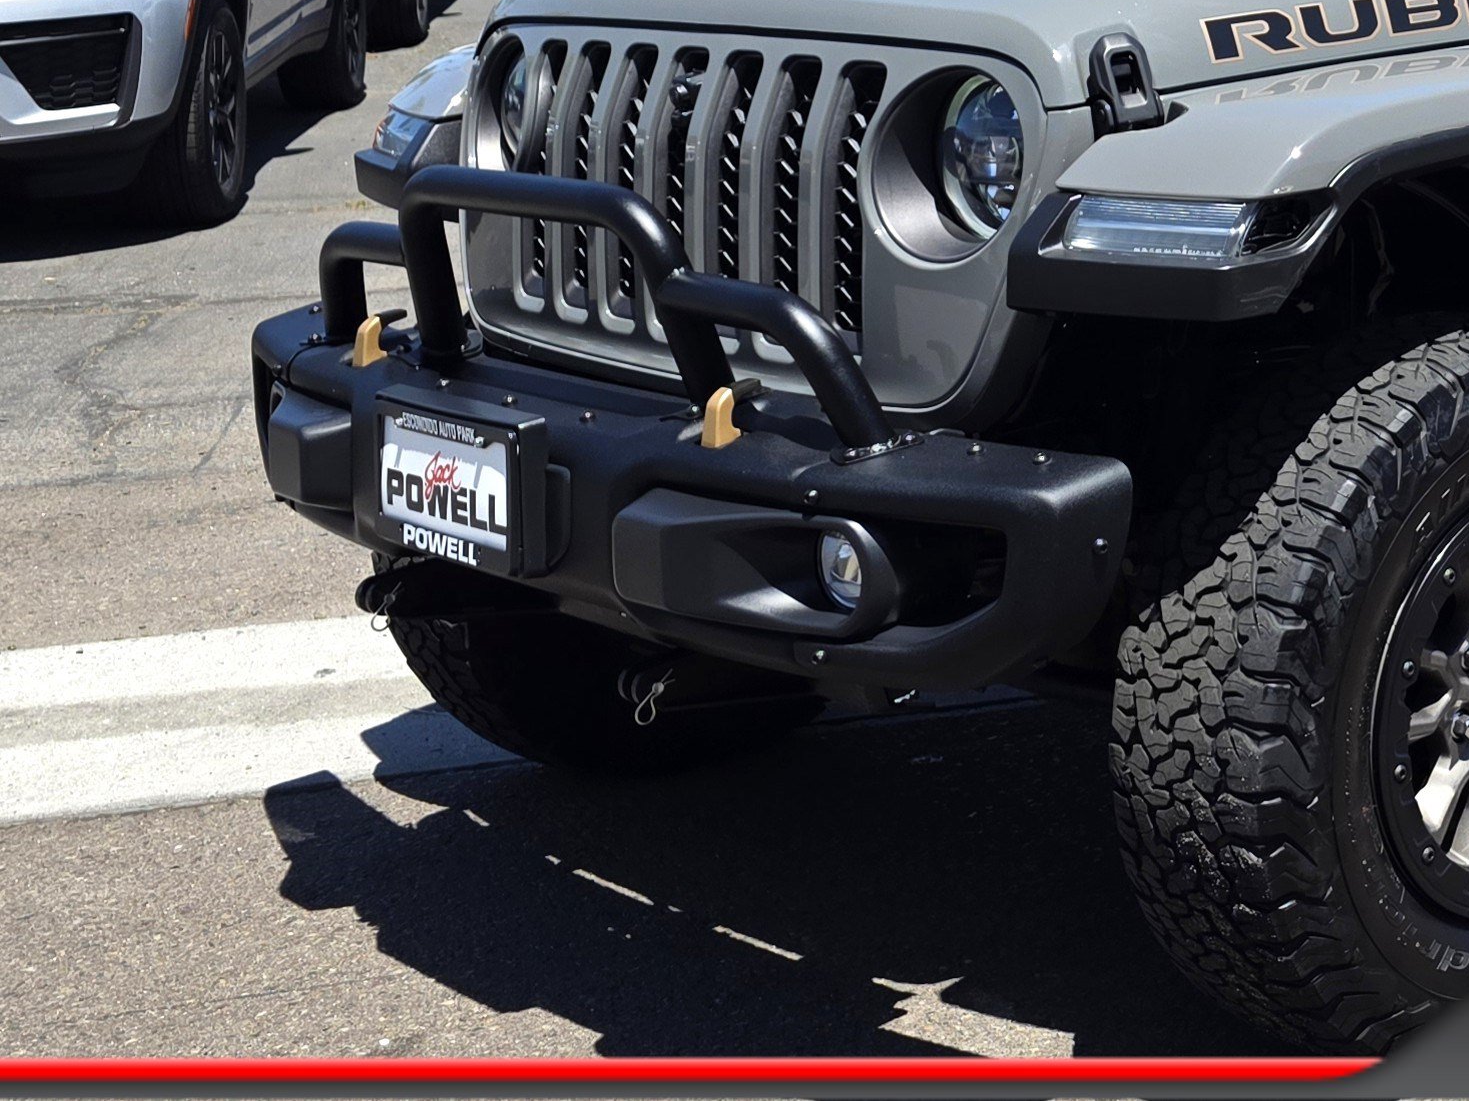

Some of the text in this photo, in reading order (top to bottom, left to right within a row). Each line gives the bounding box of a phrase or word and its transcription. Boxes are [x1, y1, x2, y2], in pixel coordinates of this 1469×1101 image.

[402, 411, 475, 444] ESCONDIDO AUTO PARK
[424, 450, 462, 500] Jack
[386, 467, 508, 536] POWELL
[403, 523, 477, 566] POWELL
